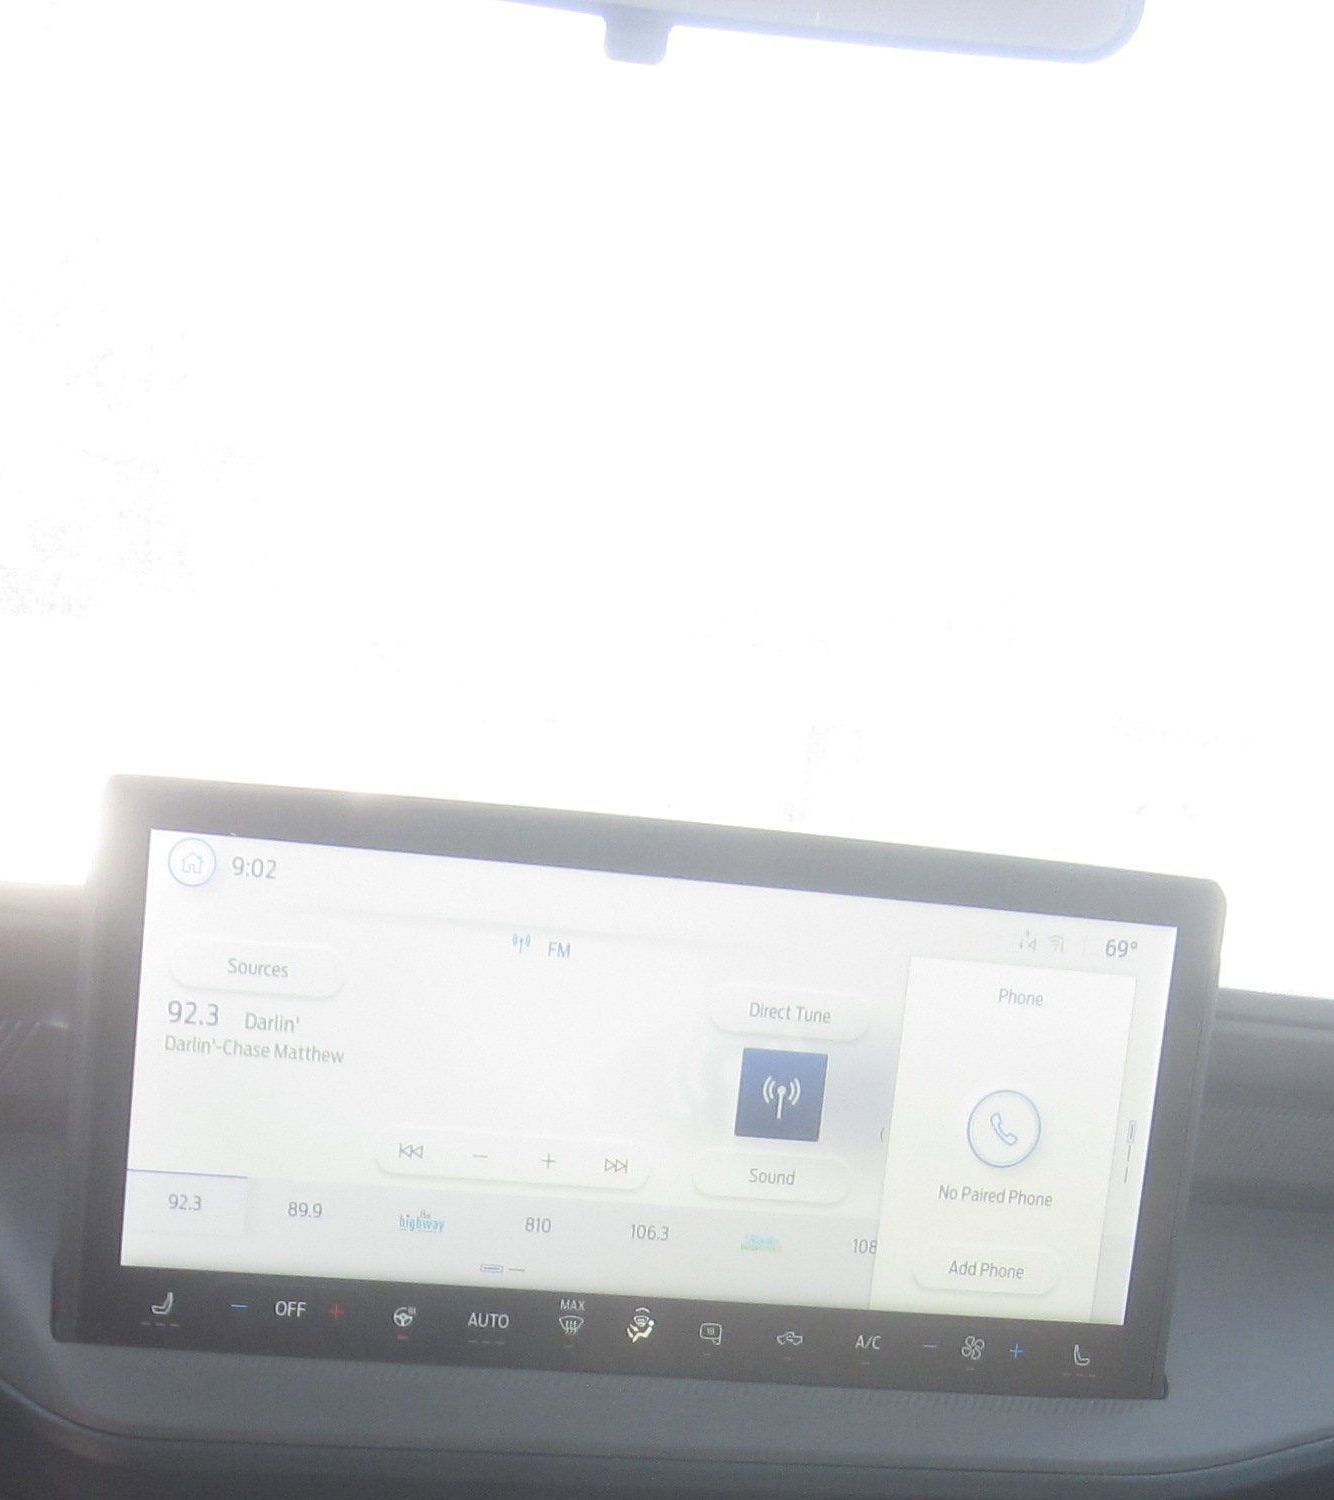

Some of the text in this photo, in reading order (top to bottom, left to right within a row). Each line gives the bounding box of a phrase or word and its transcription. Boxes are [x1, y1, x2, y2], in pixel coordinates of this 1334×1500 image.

[231, 856, 278, 880] 9:02
[547, 941, 571, 960] FM
[227, 957, 289, 978] Sources
[998, 987, 1044, 1007] Phone
[167, 1000, 301, 1034] 92.3 Darlin'
[748, 1001, 832, 1024] Direct Tune
[273, 1042, 346, 1064] Matthew
[748, 1168, 797, 1186] Sound
[167, 1193, 203, 1212] 92.3
[938, 1184, 1053, 1207] No Paired Phone
[287, 1201, 323, 1219] 89.9
[398, 1213, 445, 1233] highway
[524, 1216, 552, 1234] 810
[630, 1223, 670, 1241] 106.3
[947, 1259, 1025, 1279] Add Phone
[274, 1300, 307, 1318] OFF
[559, 1299, 587, 1312] MAX
[467, 1312, 510, 1330] AUTO
[855, 1334, 883, 1350] A/C
